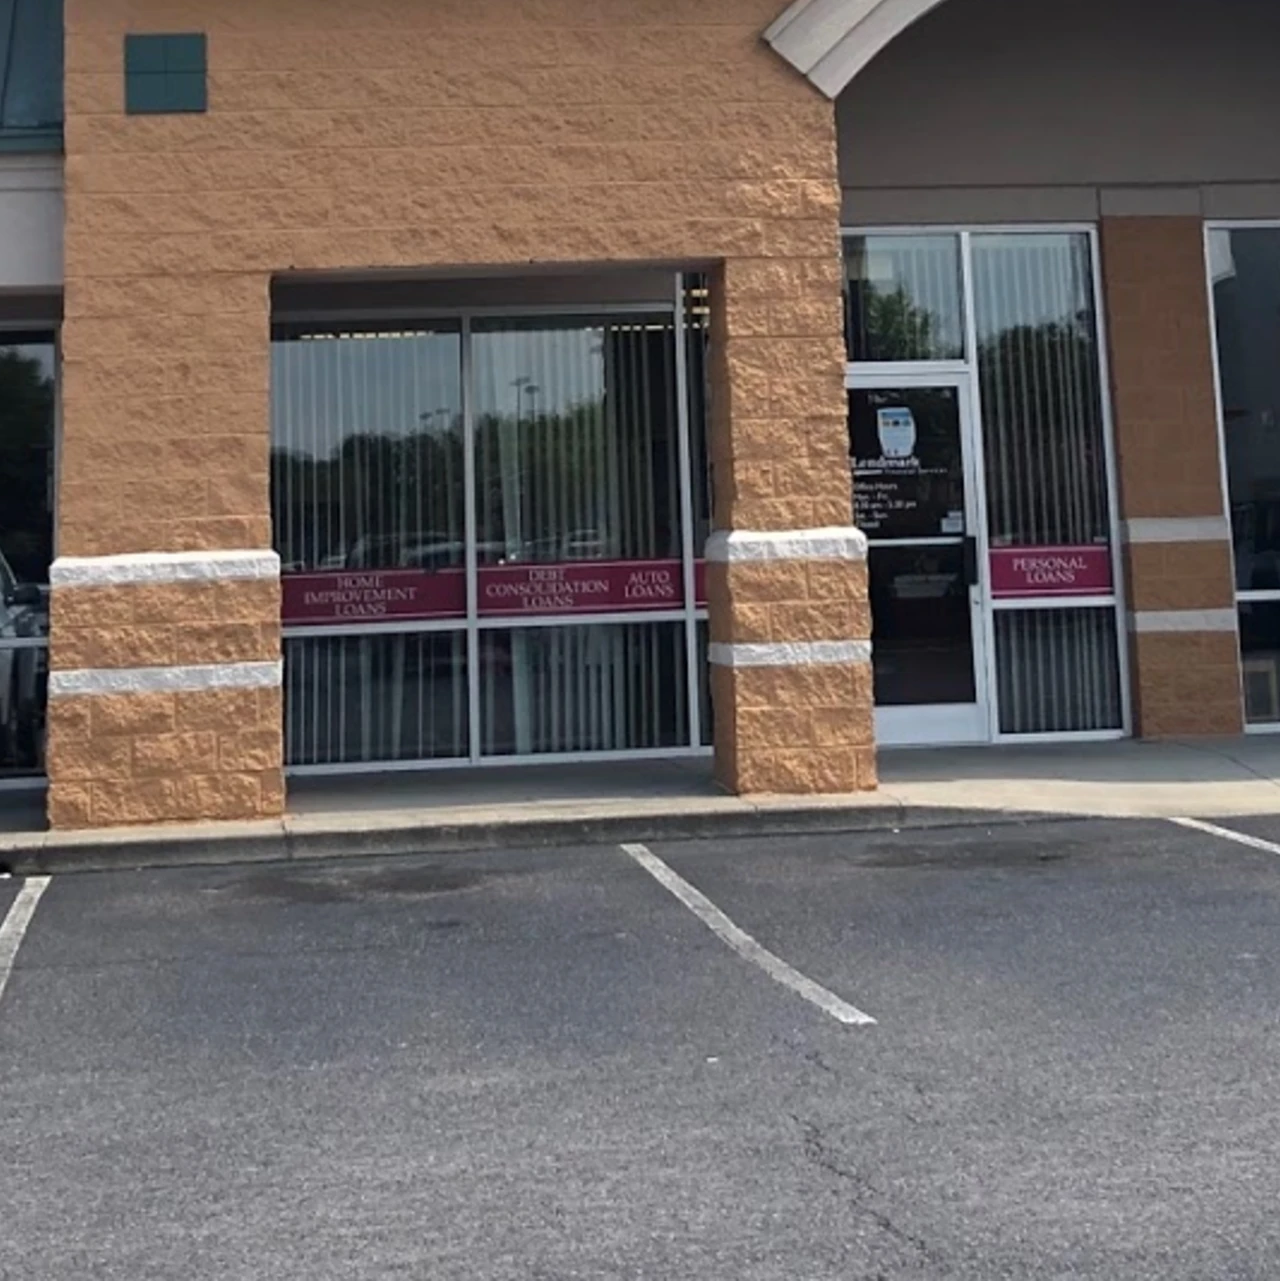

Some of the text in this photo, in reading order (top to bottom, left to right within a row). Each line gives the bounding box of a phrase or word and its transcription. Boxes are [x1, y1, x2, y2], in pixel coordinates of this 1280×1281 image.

[851, 455, 920, 469] Lendmark
[1012, 556, 1088, 571] PERSONAL
[337, 576, 385, 589] HOME
[528, 569, 565, 582] DEBT
[628, 571, 670, 585] AUTO
[1025, 570, 1076, 583] LOANS
[303, 587, 418, 604] IMPROVEMENT
[485, 579, 610, 598] CONSOLIDATION
[624, 583, 675, 598] LOANS
[522, 595, 574, 608] LOANS
[334, 602, 387, 616] LOANS
